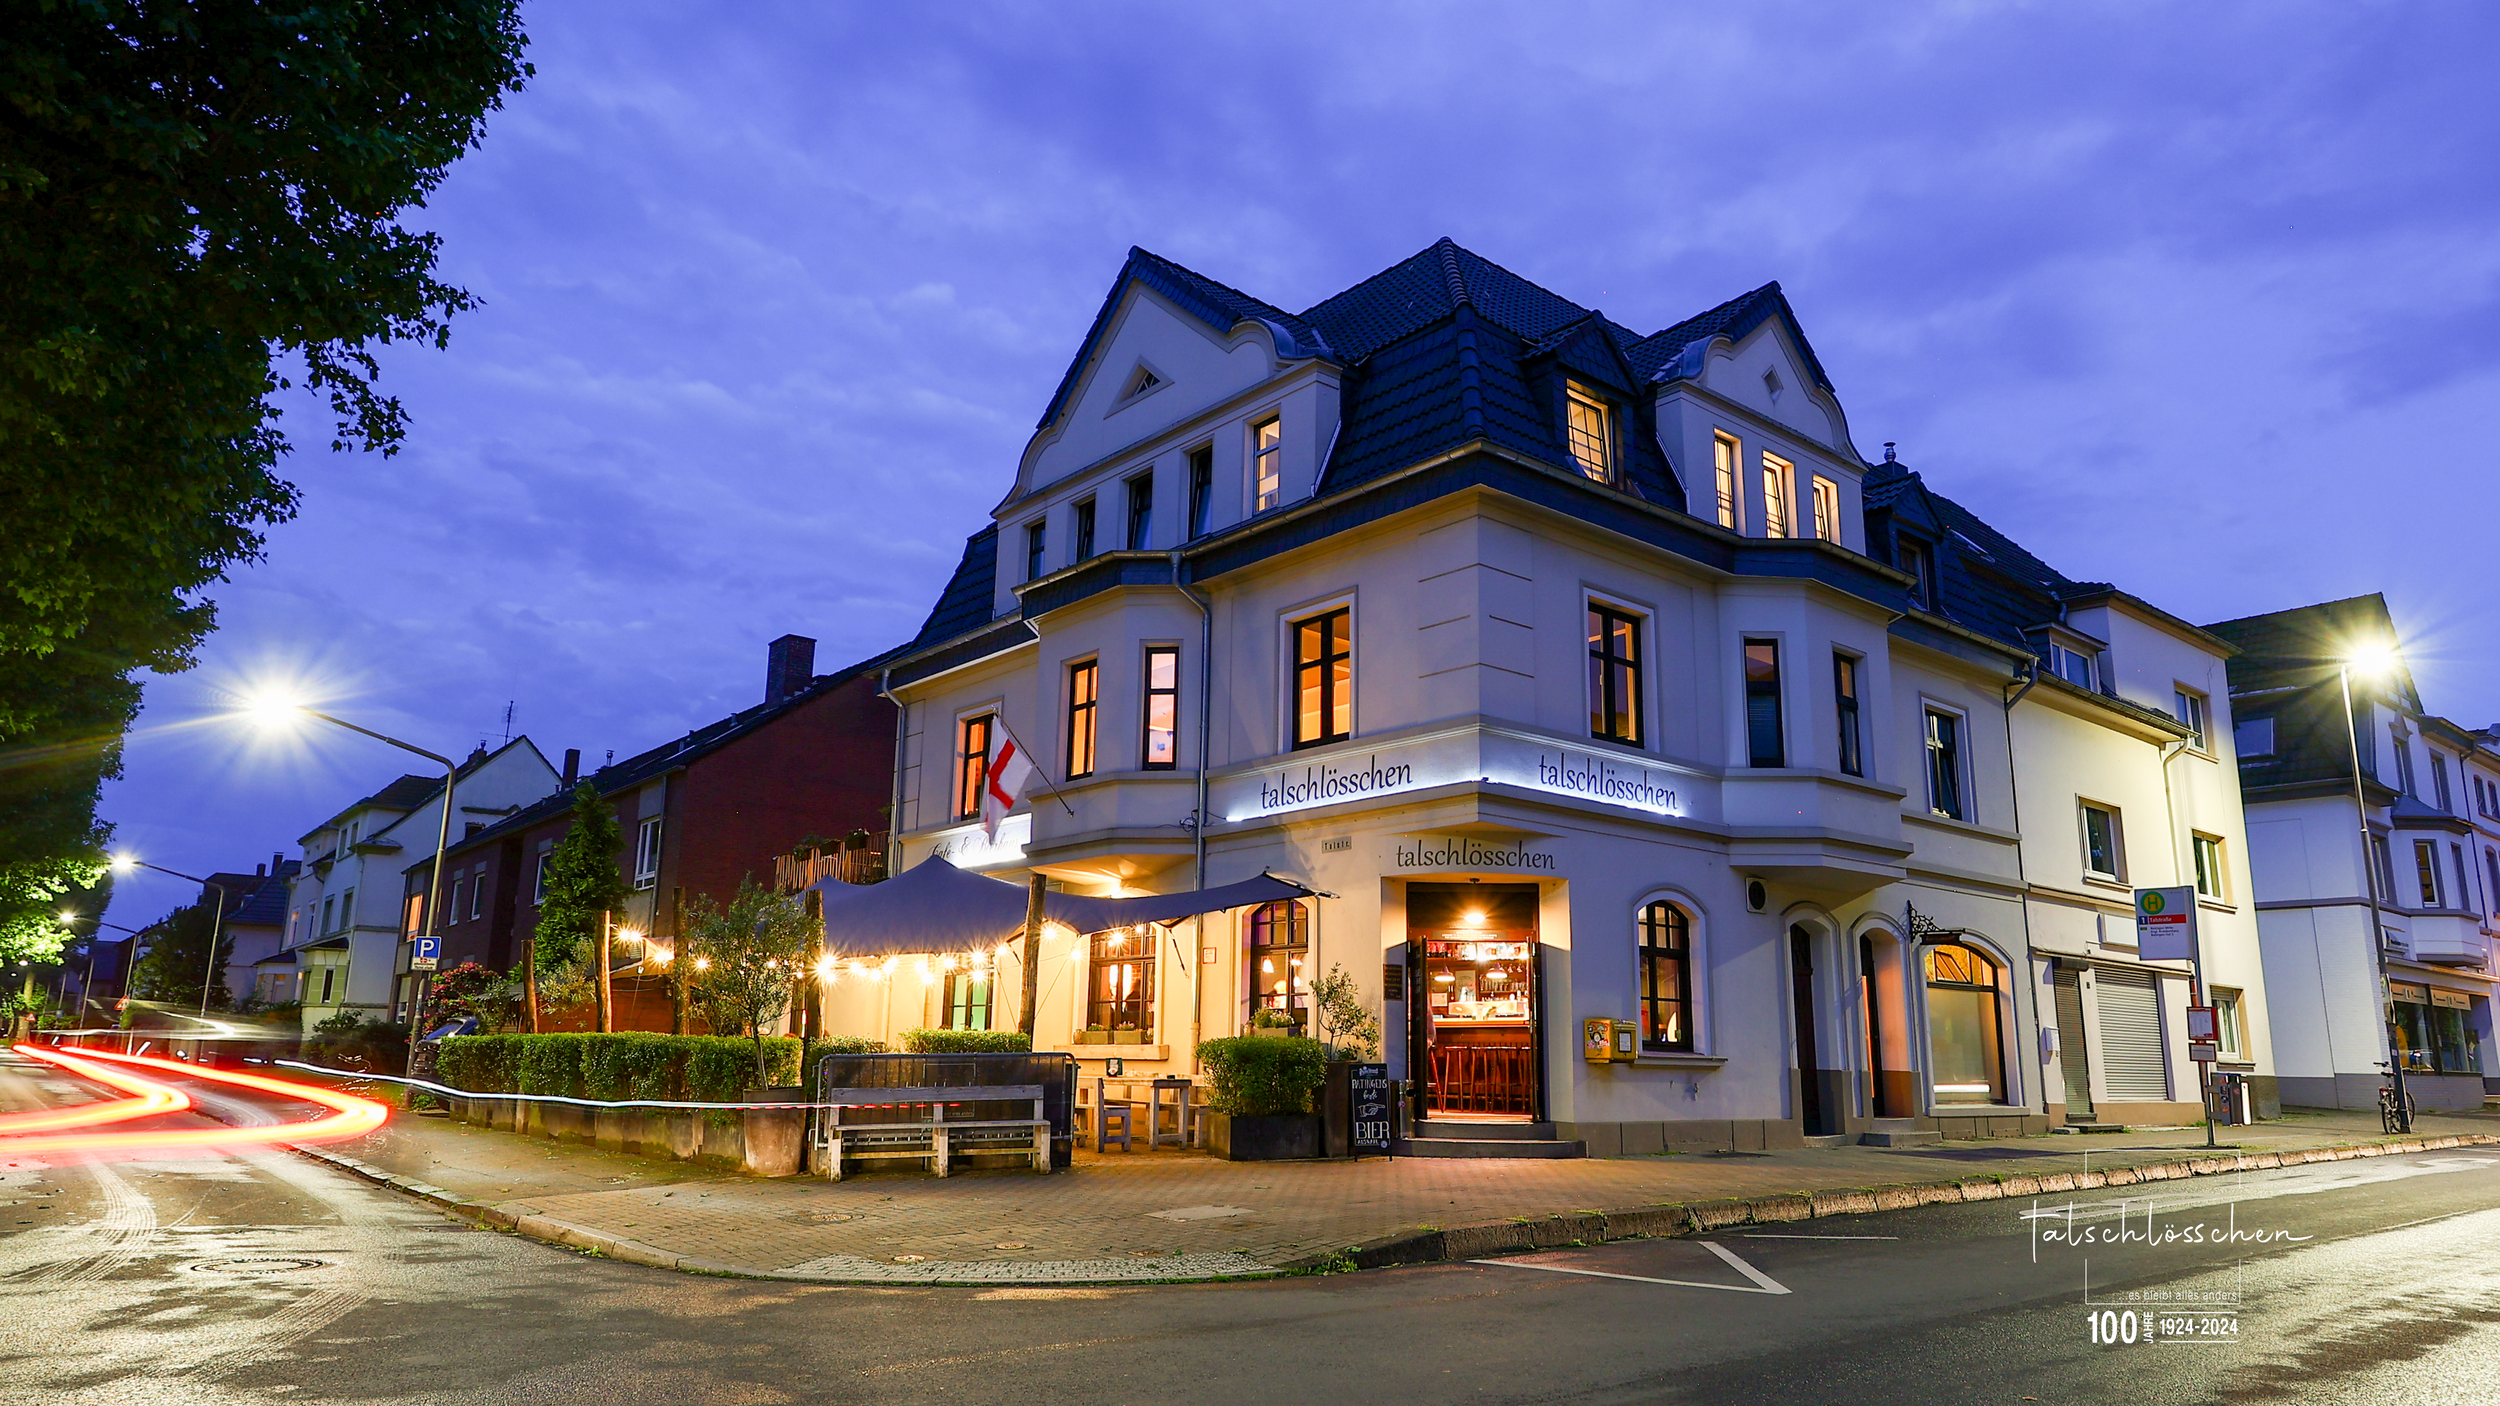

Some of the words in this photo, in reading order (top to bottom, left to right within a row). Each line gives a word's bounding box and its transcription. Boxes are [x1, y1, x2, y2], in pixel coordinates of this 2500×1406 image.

[1261, 755, 1413, 809] talschlösschen
[1538, 753, 1678, 809] talschlösschen
[1396, 838, 1555, 870] talschlösschen
[420, 939, 435, 957] P
[1355, 1121, 1390, 1139] BIER
